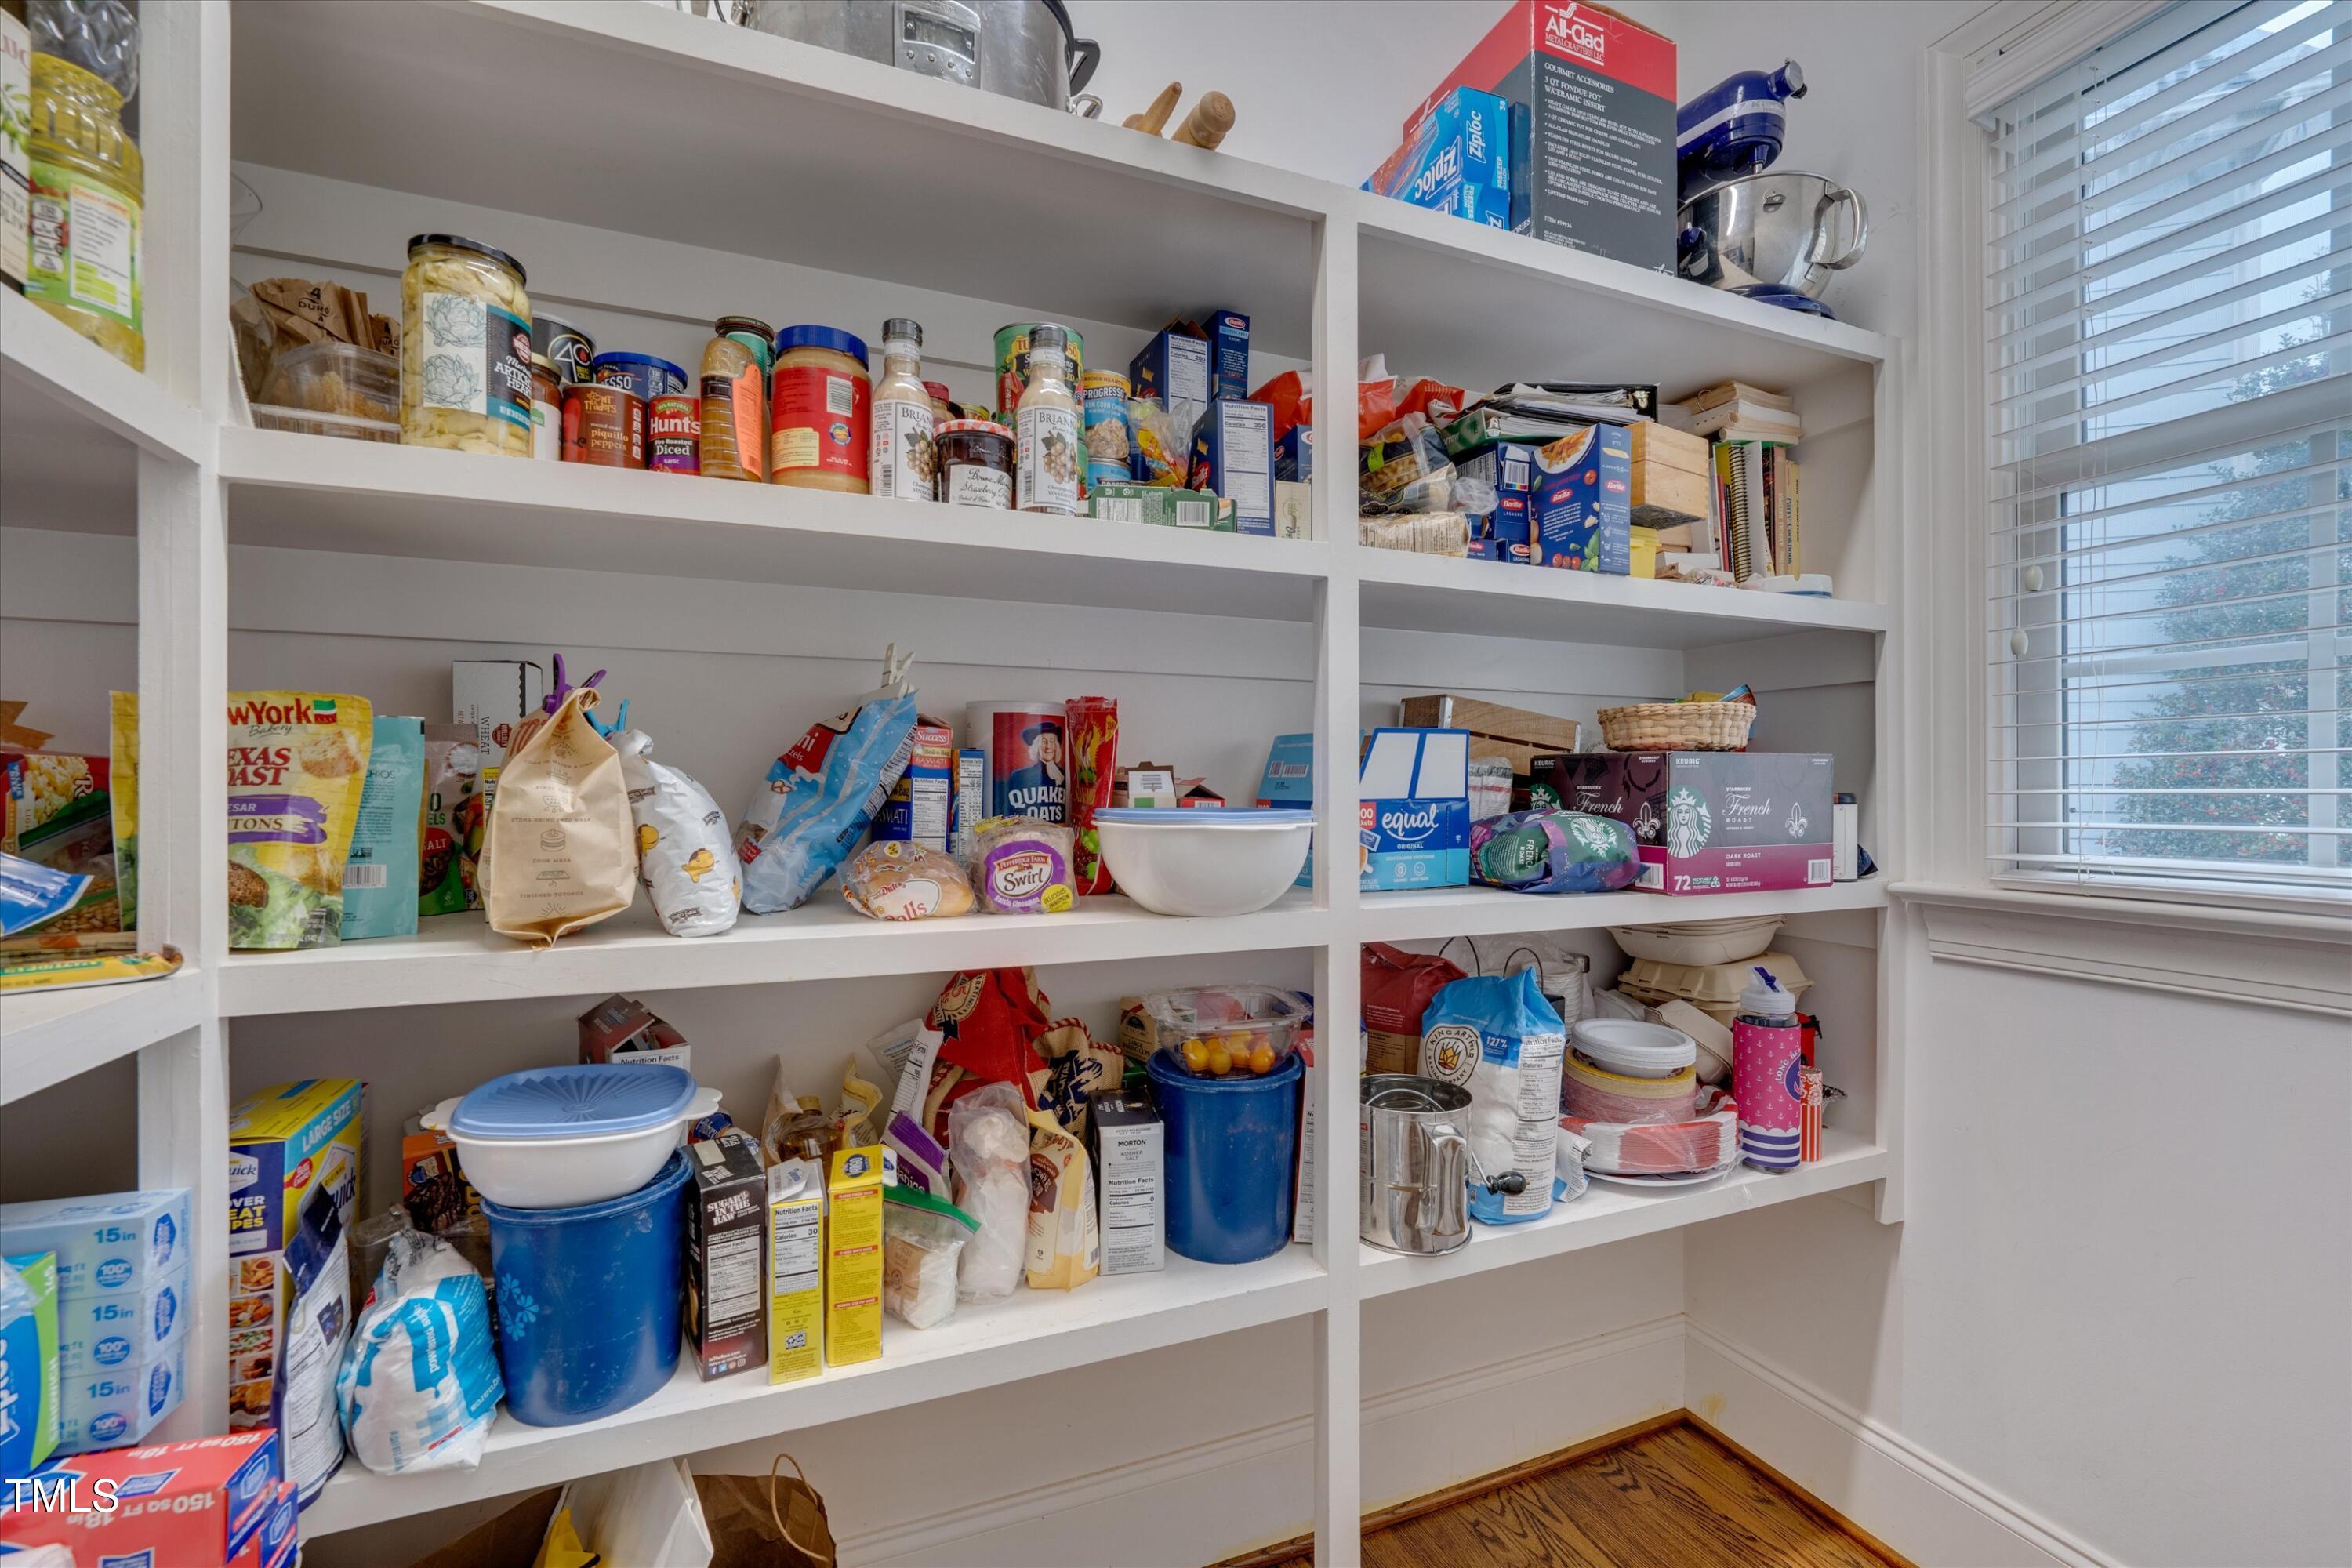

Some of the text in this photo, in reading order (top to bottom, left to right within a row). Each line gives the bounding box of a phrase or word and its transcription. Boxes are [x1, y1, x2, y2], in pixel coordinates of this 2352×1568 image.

[1545, 15, 1605, 54] All-Clad
[1545, 32, 1605, 62] METALCRAFTERS LLC
[1544, 63, 1615, 94] GOURMET ACCESSORIES
[1550, 78, 1559, 87] QT
[1560, 81, 1588, 98] FONDUE
[1588, 91, 1602, 102] POT
[1544, 85, 1606, 113] W/CERAMIC INSERT
[1468, 110, 1487, 158] Ziploc
[1414, 146, 1458, 199] Ziploc
[310, 287, 321, 299] 4
[298, 301, 330, 314] DURO
[605, 376, 632, 390] ESSO
[1084, 387, 1125, 400] PROGRESSO
[667, 401, 690, 412] NATURAL
[902, 407, 934, 426] BRIAN
[1039, 412, 1077, 430] BRIANN
[590, 429, 629, 443] piquillo
[666, 438, 693, 447] Roasted
[590, 438, 628, 452] peppers
[656, 445, 691, 456] Diced
[968, 467, 993, 483] Bonne
[960, 483, 997, 498] Strawberry
[1607, 481, 1626, 491] Barilla
[1552, 490, 1572, 503] Barilla
[227, 697, 312, 726] wYork
[247, 724, 293, 737] Bakery
[480, 715, 490, 755] WHEAT
[916, 731, 948, 742] Success
[227, 746, 292, 767] EXAS
[915, 757, 946, 766] BASMATI
[227, 766, 289, 787] AST
[1008, 786, 1065, 808] QUAKE
[1573, 790, 1624, 815] French
[1722, 793, 1772, 817] French
[875, 808, 909, 825] ASMATI
[1026, 805, 1062, 823] OATS
[1359, 808, 1374, 819] 00
[1381, 803, 1439, 837] equal
[232, 817, 285, 830] TONS
[423, 837, 448, 851] ALT
[1000, 855, 1047, 870] PEPPERIDGE FARM
[1004, 867, 1044, 892] Swirl
[1673, 874, 1692, 891] 72
[993, 895, 1040, 908] Raisin Cinnamon
[1430, 1029, 1453, 1046] KING
[1485, 1036, 1508, 1049] 127%
[659, 1054, 680, 1063] Facts
[1774, 1058, 1789, 1082] LONG
[302, 1099, 351, 1154] LARGE SIZE
[1117, 1139, 1147, 1148] MORTON
[229, 1162, 257, 1176] uick
[895, 1165, 926, 1193] anics
[1109, 1178, 1137, 1187] Nutrition
[706, 1191, 746, 1213] SUGAR
[713, 1198, 750, 1218] IN THE
[712, 1212, 737, 1227] RAW
[775, 1207, 800, 1216] Nutrition
[710, 1243, 732, 1252] Nutrition
[425, 1326, 441, 1374] powdered
[174, 1440, 198, 1453] FT
[220, 1432, 262, 1447] 150
[121, 1501, 144, 1517] FT
[171, 1493, 216, 1515] 150
